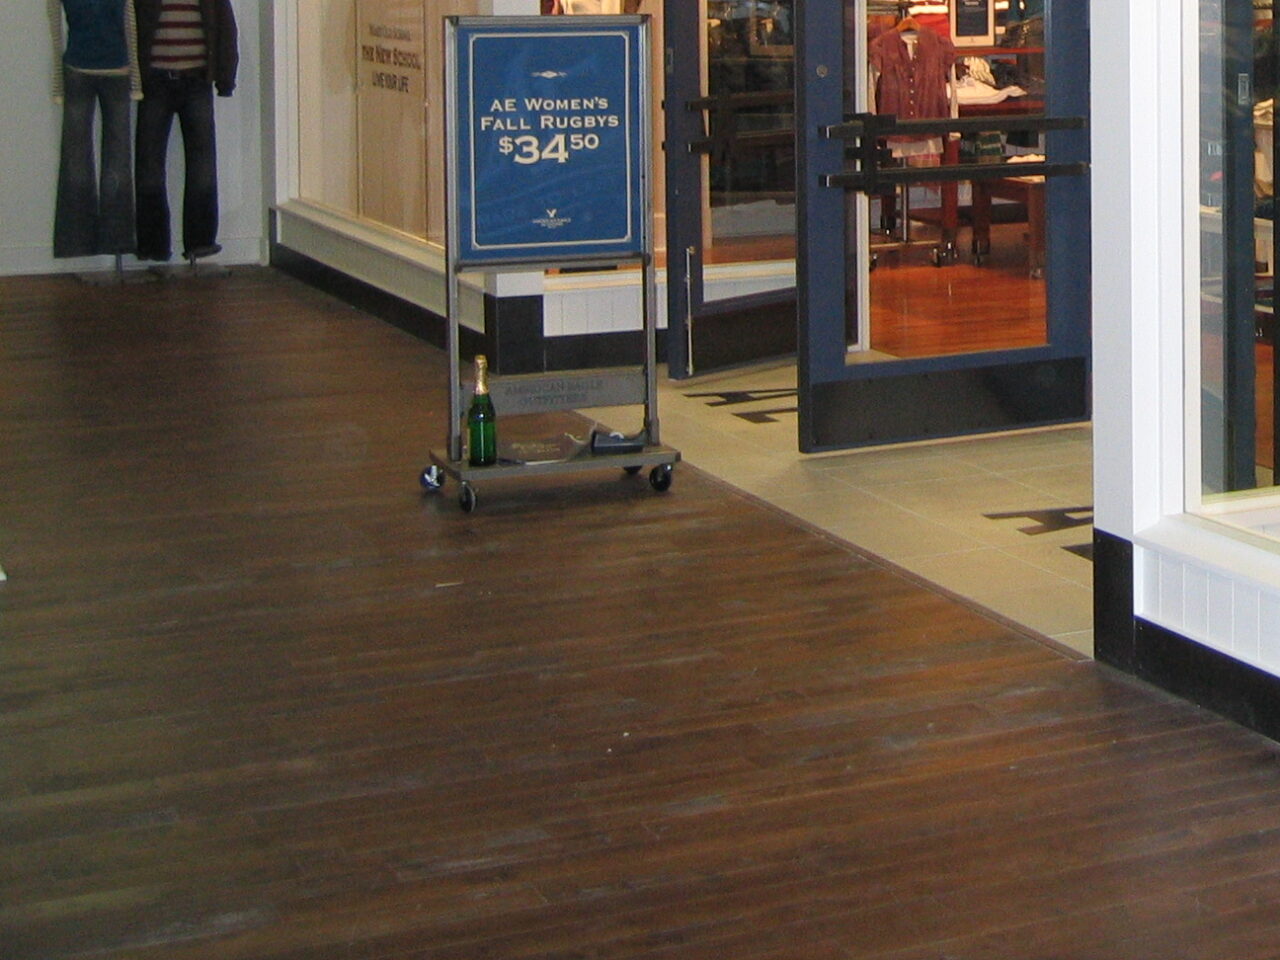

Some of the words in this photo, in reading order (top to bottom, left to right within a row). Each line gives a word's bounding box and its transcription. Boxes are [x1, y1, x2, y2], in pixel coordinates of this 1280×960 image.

[490, 98, 517, 112] AE
[525, 96, 609, 111] WOMEN'S
[480, 116, 531, 131] FALL
[540, 115, 619, 129] RUGBYS
